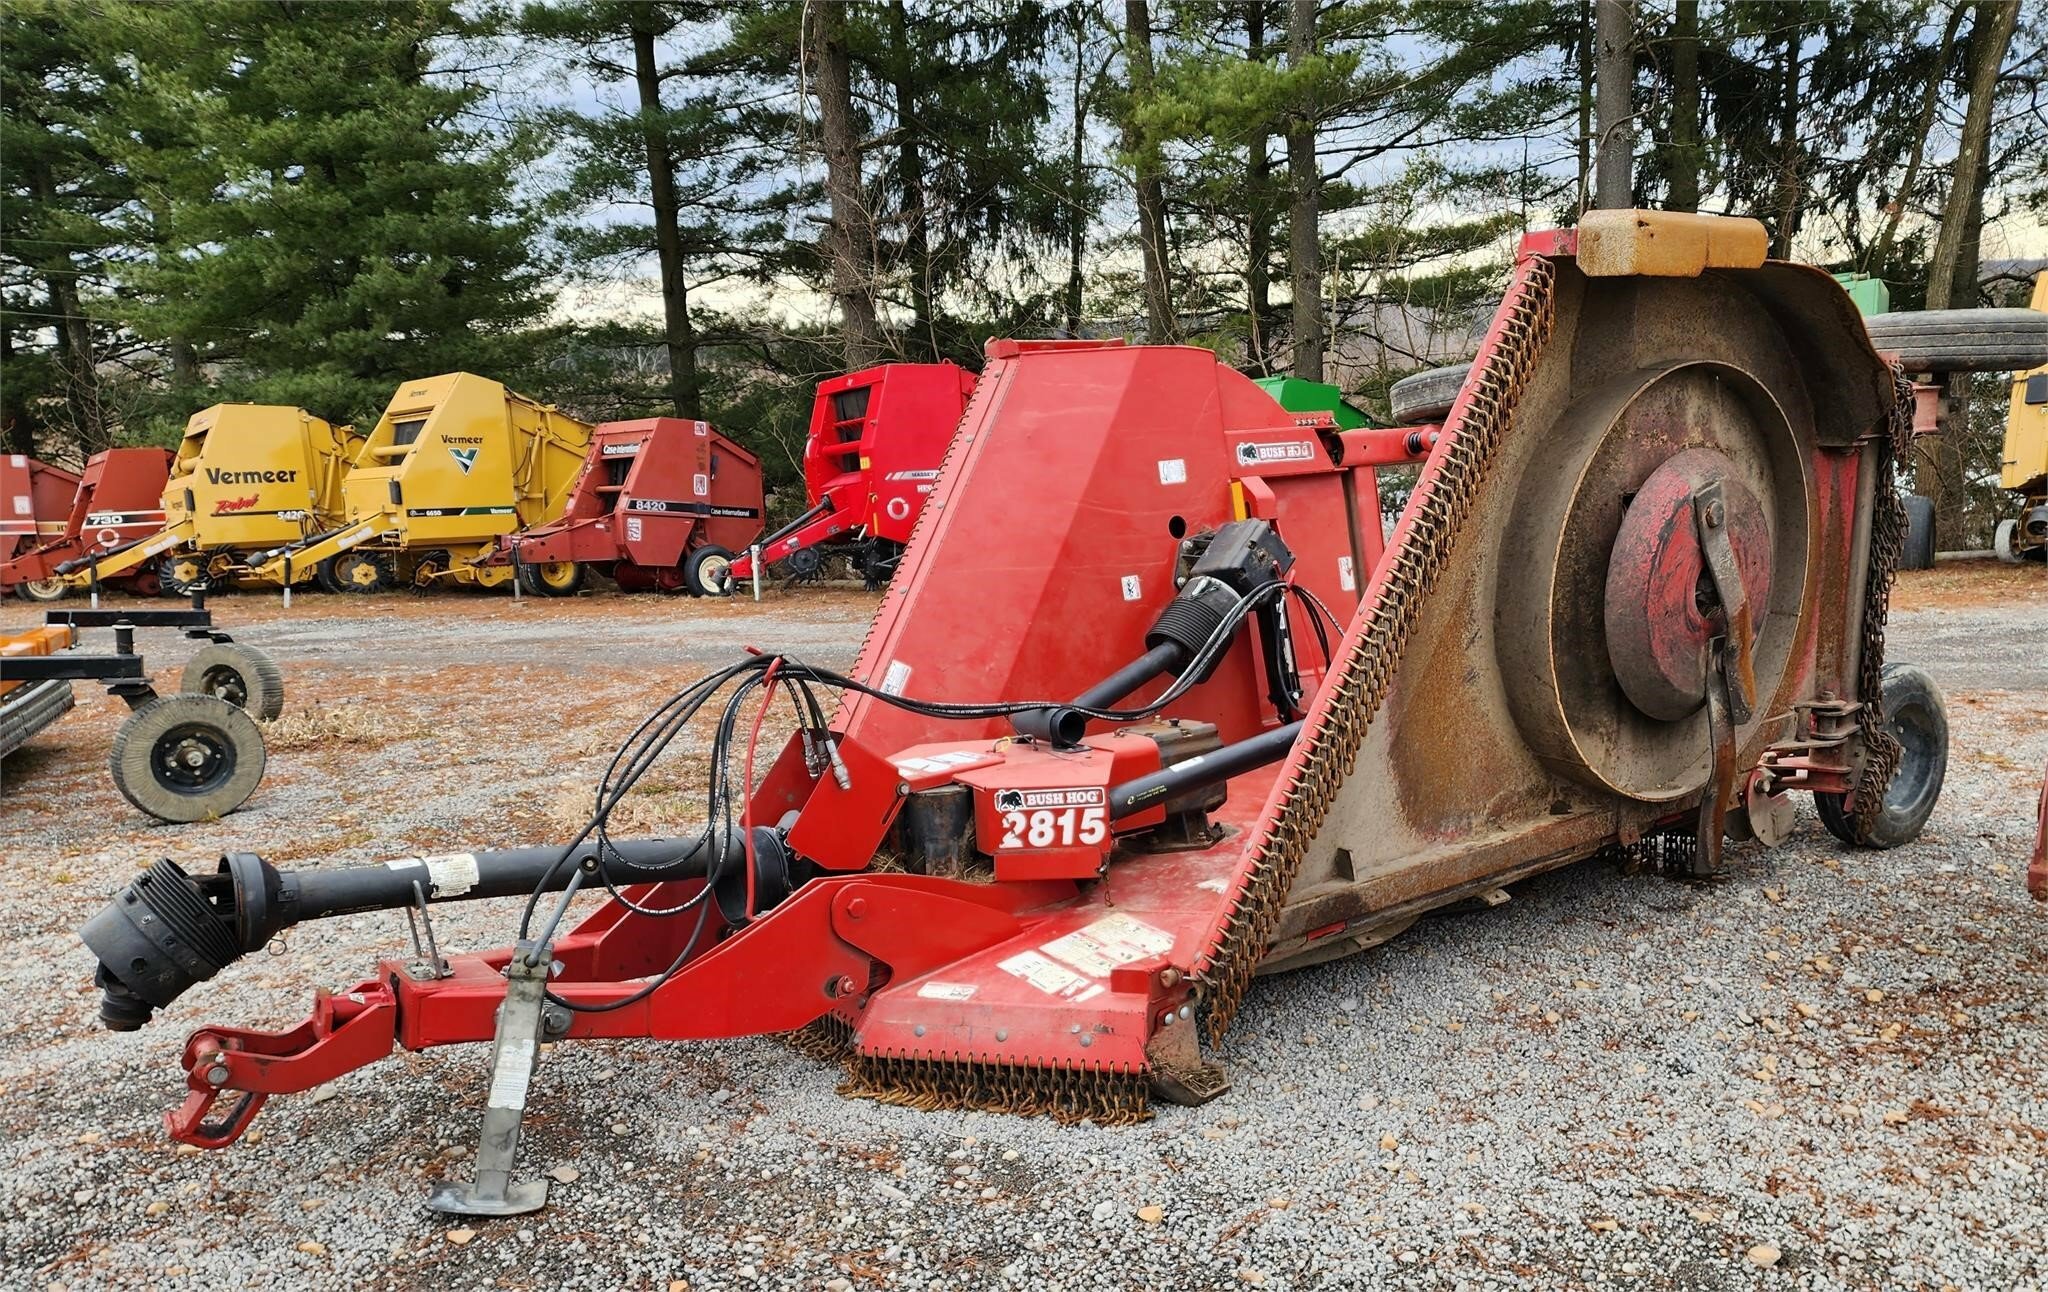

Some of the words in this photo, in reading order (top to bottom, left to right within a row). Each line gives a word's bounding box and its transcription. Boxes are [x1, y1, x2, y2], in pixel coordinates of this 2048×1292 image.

[441, 434, 484, 444] Vermeer
[603, 445, 616, 454] Case
[1260, 446, 1286, 458] BUSH
[205, 467, 297, 485] Vermeer
[636, 501, 666, 511] 8420
[722, 508, 749, 516] International
[90, 515, 122, 525] 730
[1026, 793, 1064, 806] BUSH
[1066, 791, 1097, 804] HOG
[999, 807, 1106, 848] 2815
